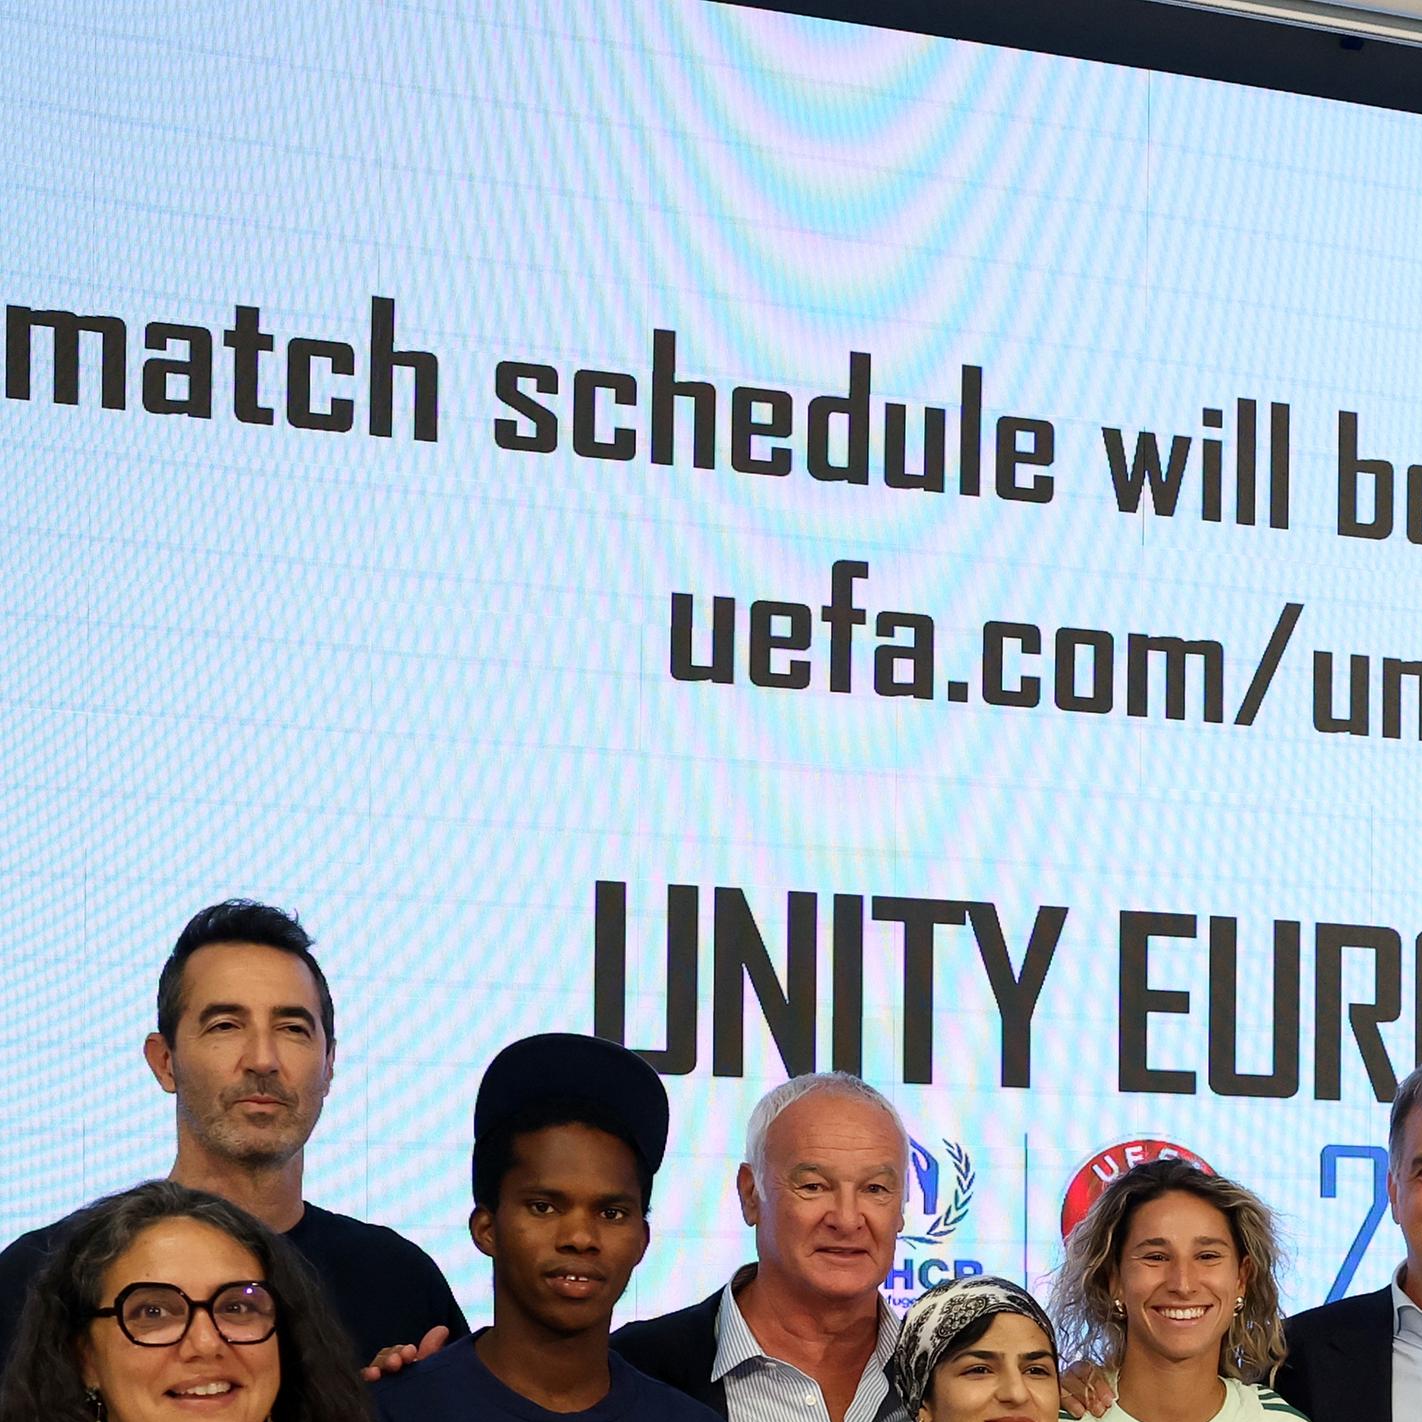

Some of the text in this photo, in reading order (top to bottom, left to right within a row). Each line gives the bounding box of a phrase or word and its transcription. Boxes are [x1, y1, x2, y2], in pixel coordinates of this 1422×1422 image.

[6, 296, 438, 442] match
[495, 329, 1054, 503] schedule
[1101, 398, 1290, 529] will
[594, 880, 1069, 1089] UNITY
